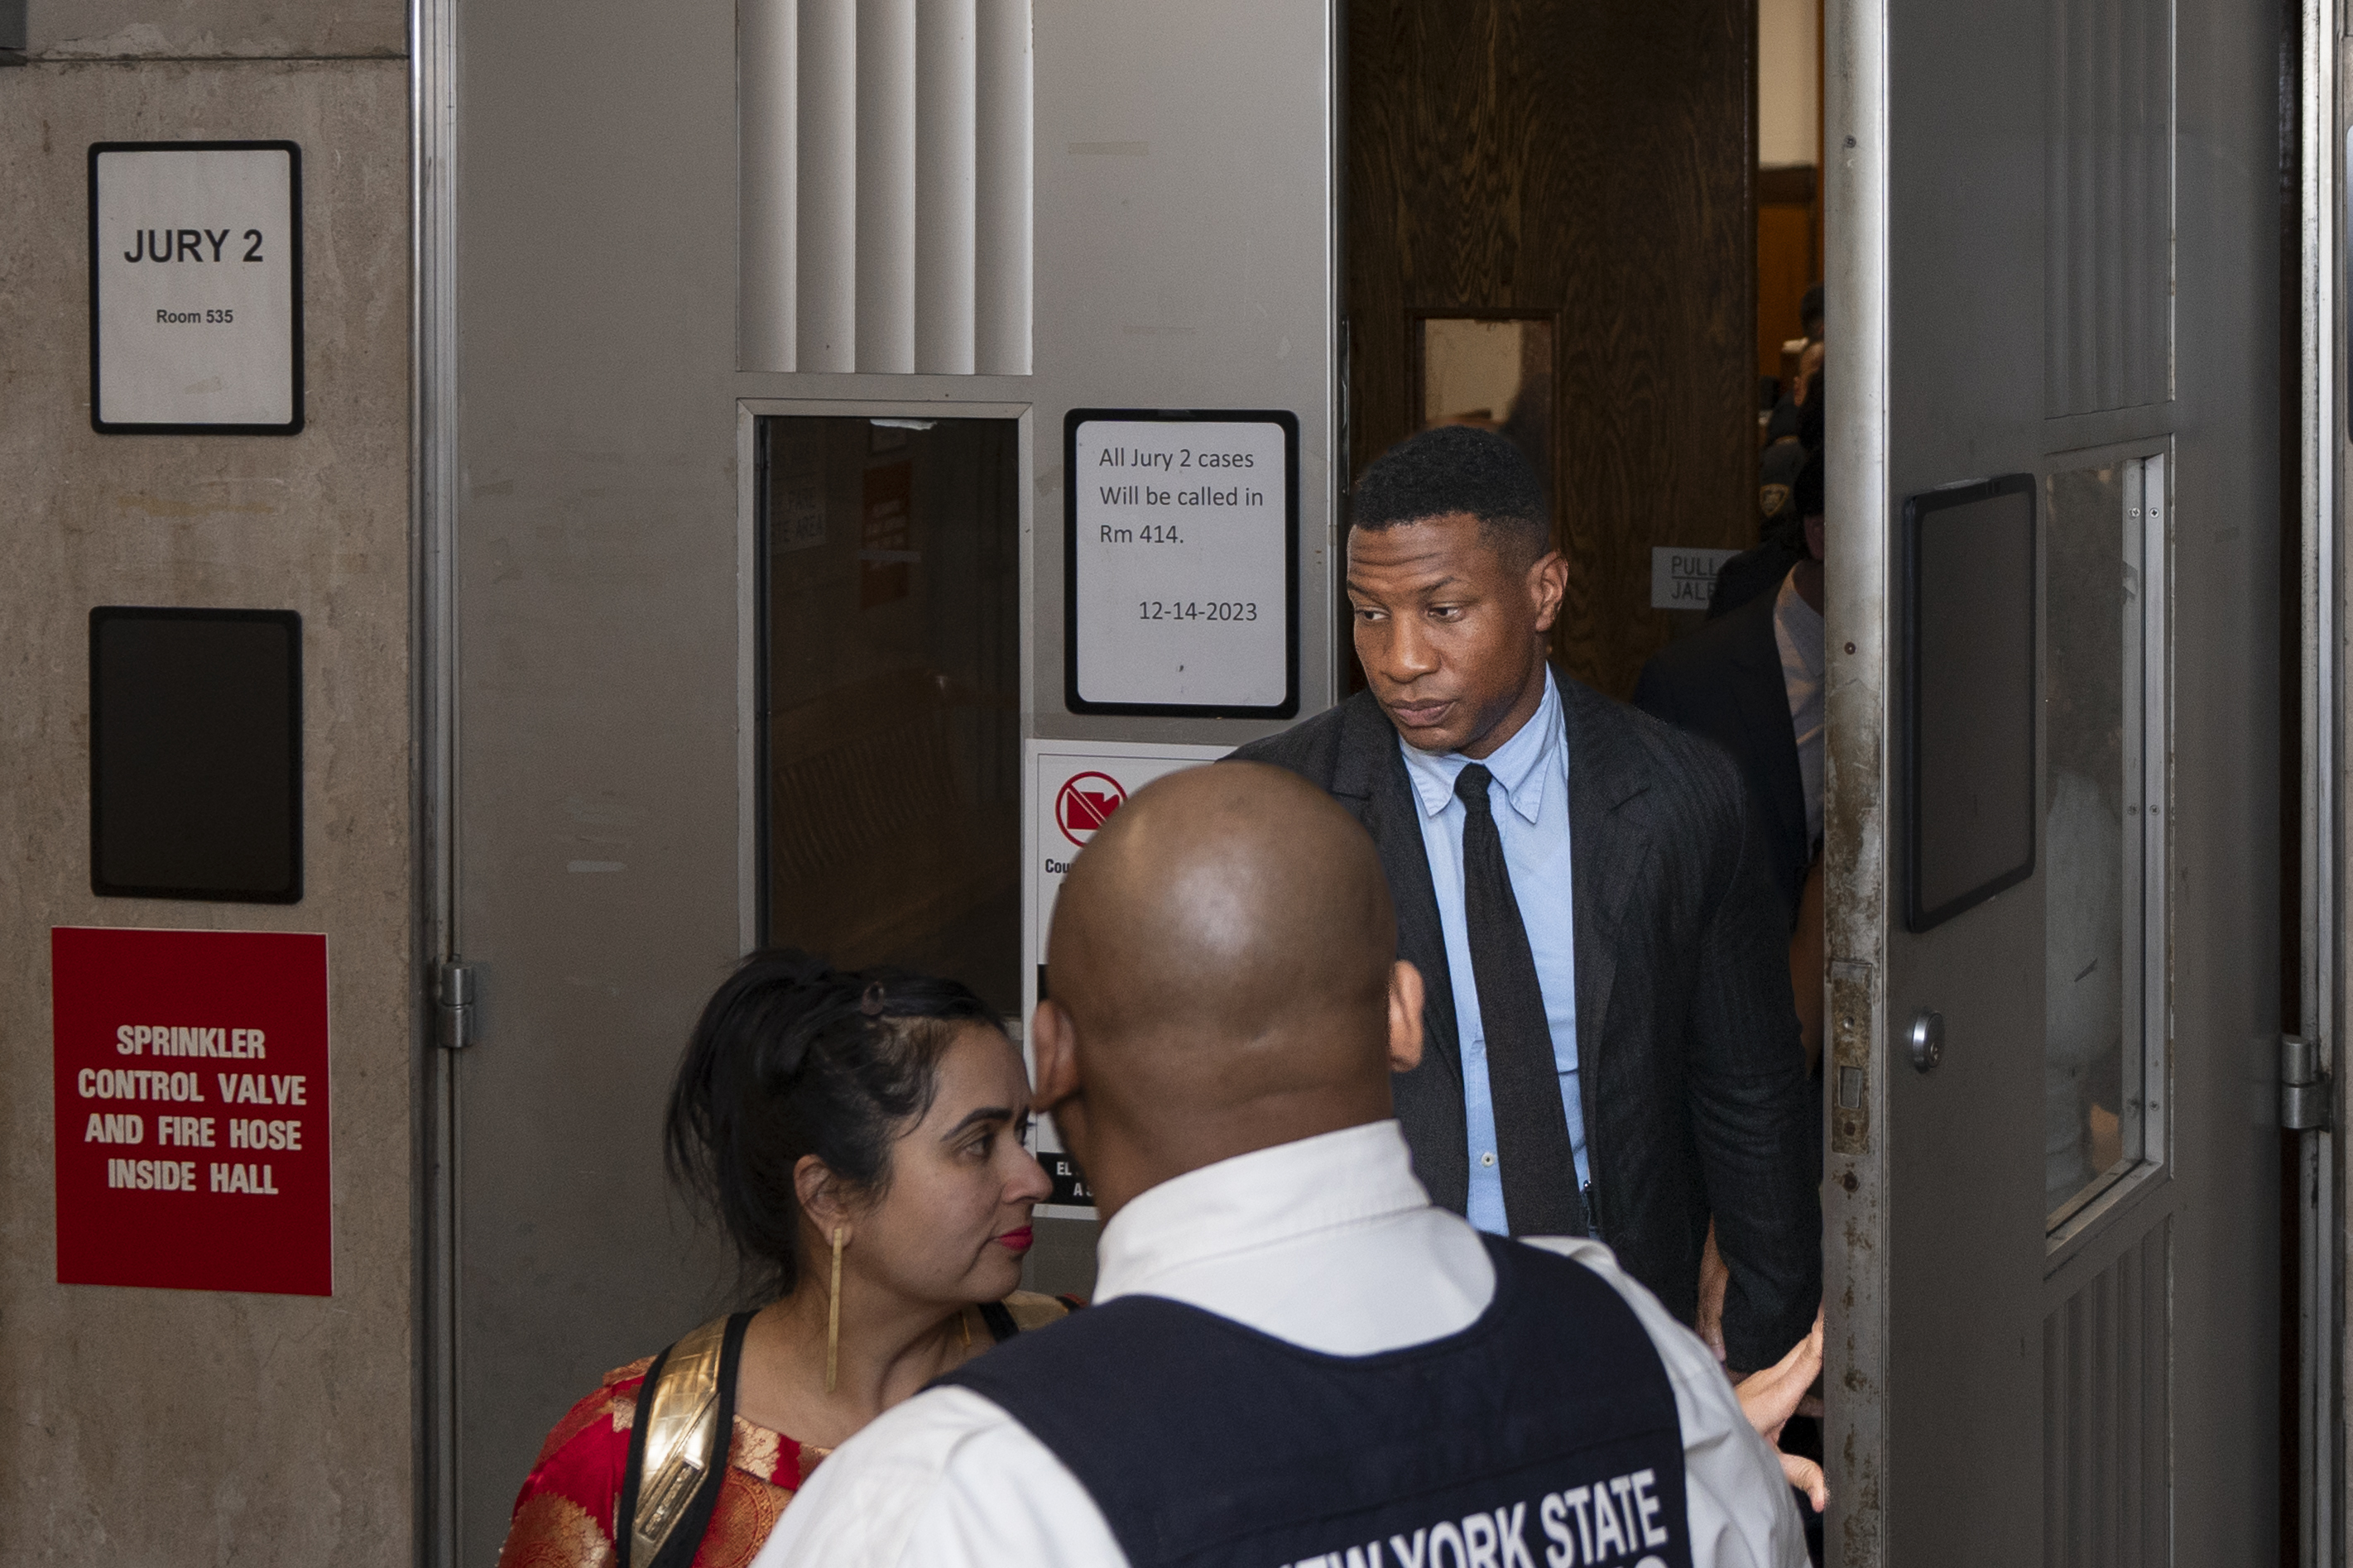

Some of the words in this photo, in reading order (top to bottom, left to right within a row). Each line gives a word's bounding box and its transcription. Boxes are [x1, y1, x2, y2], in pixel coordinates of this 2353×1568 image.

[123, 228, 231, 264] JURY
[243, 228, 264, 262] 2
[156, 309, 202, 324] Room
[205, 309, 233, 324] 535
[1098, 448, 1125, 467] All
[1131, 448, 1174, 472] Jury
[1179, 448, 1192, 468] 2
[1198, 453, 1254, 468] cases
[1099, 486, 1139, 506] Will
[1145, 487, 1171, 506] be
[1177, 487, 1238, 506] called
[1245, 487, 1264, 506] in
[1100, 525, 1133, 544] Rm
[1139, 525, 1184, 544] 414.
[1671, 555, 1717, 577] PULL
[1138, 601, 1258, 621] 12-14-2023
[116, 1024, 267, 1059] SPRINKLER
[78, 1067, 205, 1102] CONTROL
[217, 1072, 307, 1105] VALVE
[84, 1113, 144, 1144] AND
[157, 1115, 216, 1148] FIRE
[229, 1119, 302, 1151] HOSE
[108, 1158, 197, 1192] INSIDE
[210, 1163, 279, 1195] HALL
[1539, 1468, 1669, 1567] STATE
